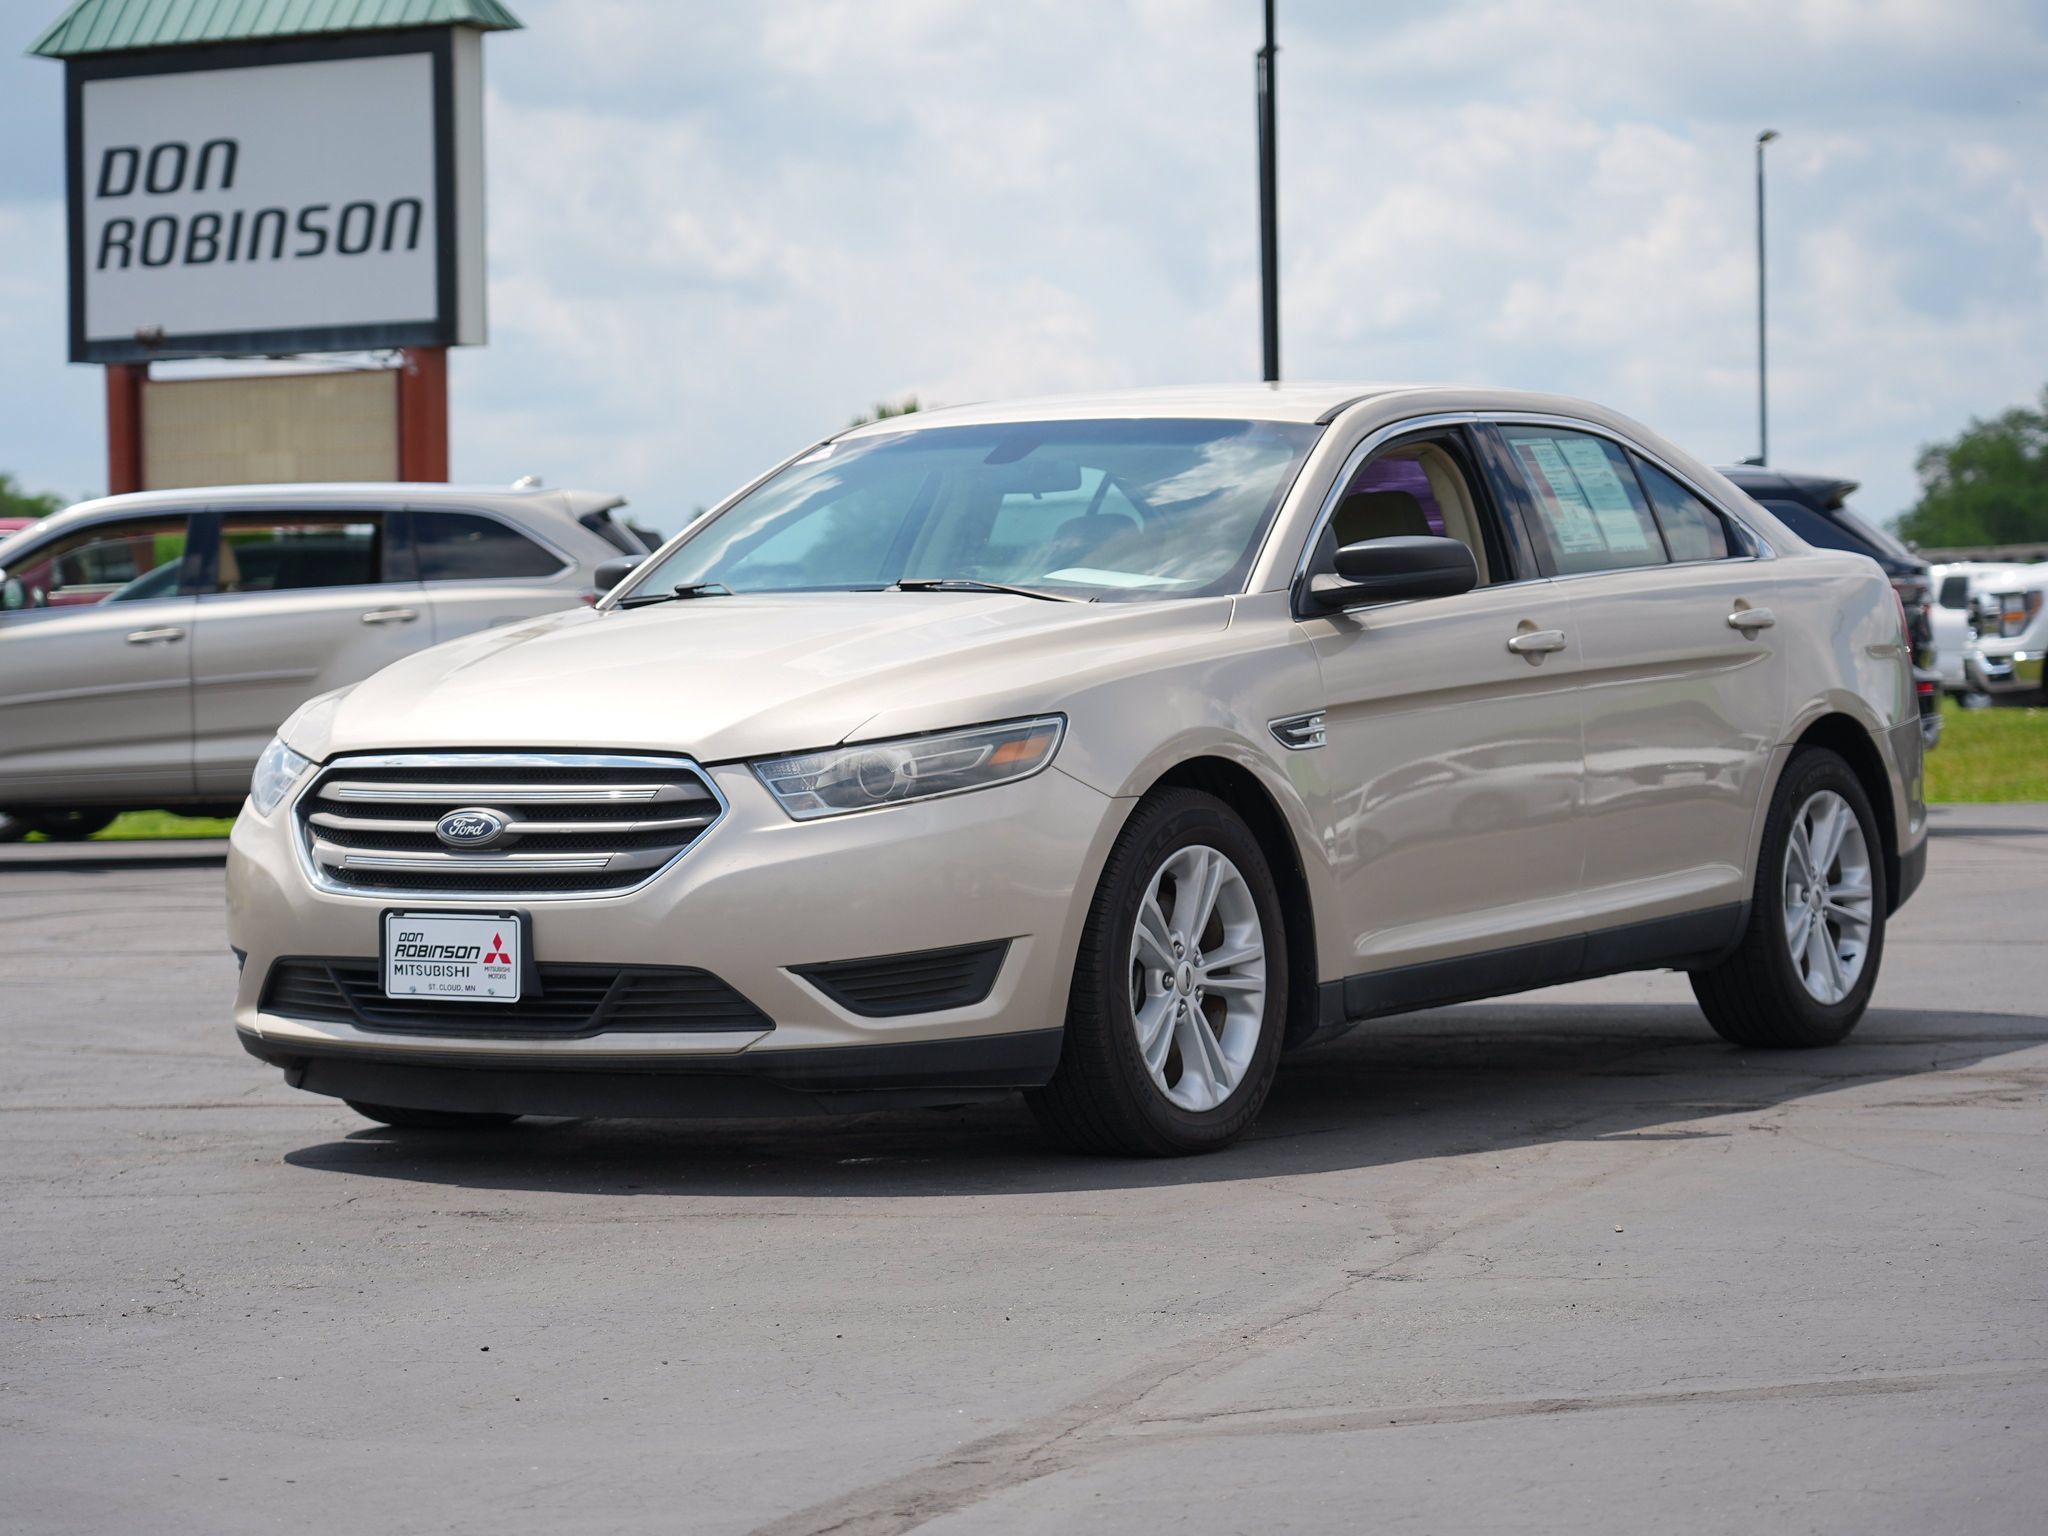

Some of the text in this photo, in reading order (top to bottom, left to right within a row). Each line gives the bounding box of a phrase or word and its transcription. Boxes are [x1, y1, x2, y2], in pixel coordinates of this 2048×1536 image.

[95, 137, 239, 199] DON
[96, 198, 423, 271] ROBINSON
[449, 817, 485, 835] Ford
[398, 932, 424, 942] DON
[394, 944, 481, 960] ROBINSON
[394, 964, 470, 978] MITSUBISHI
[428, 983, 438, 991] ST.
[464, 984, 476, 992] MN
